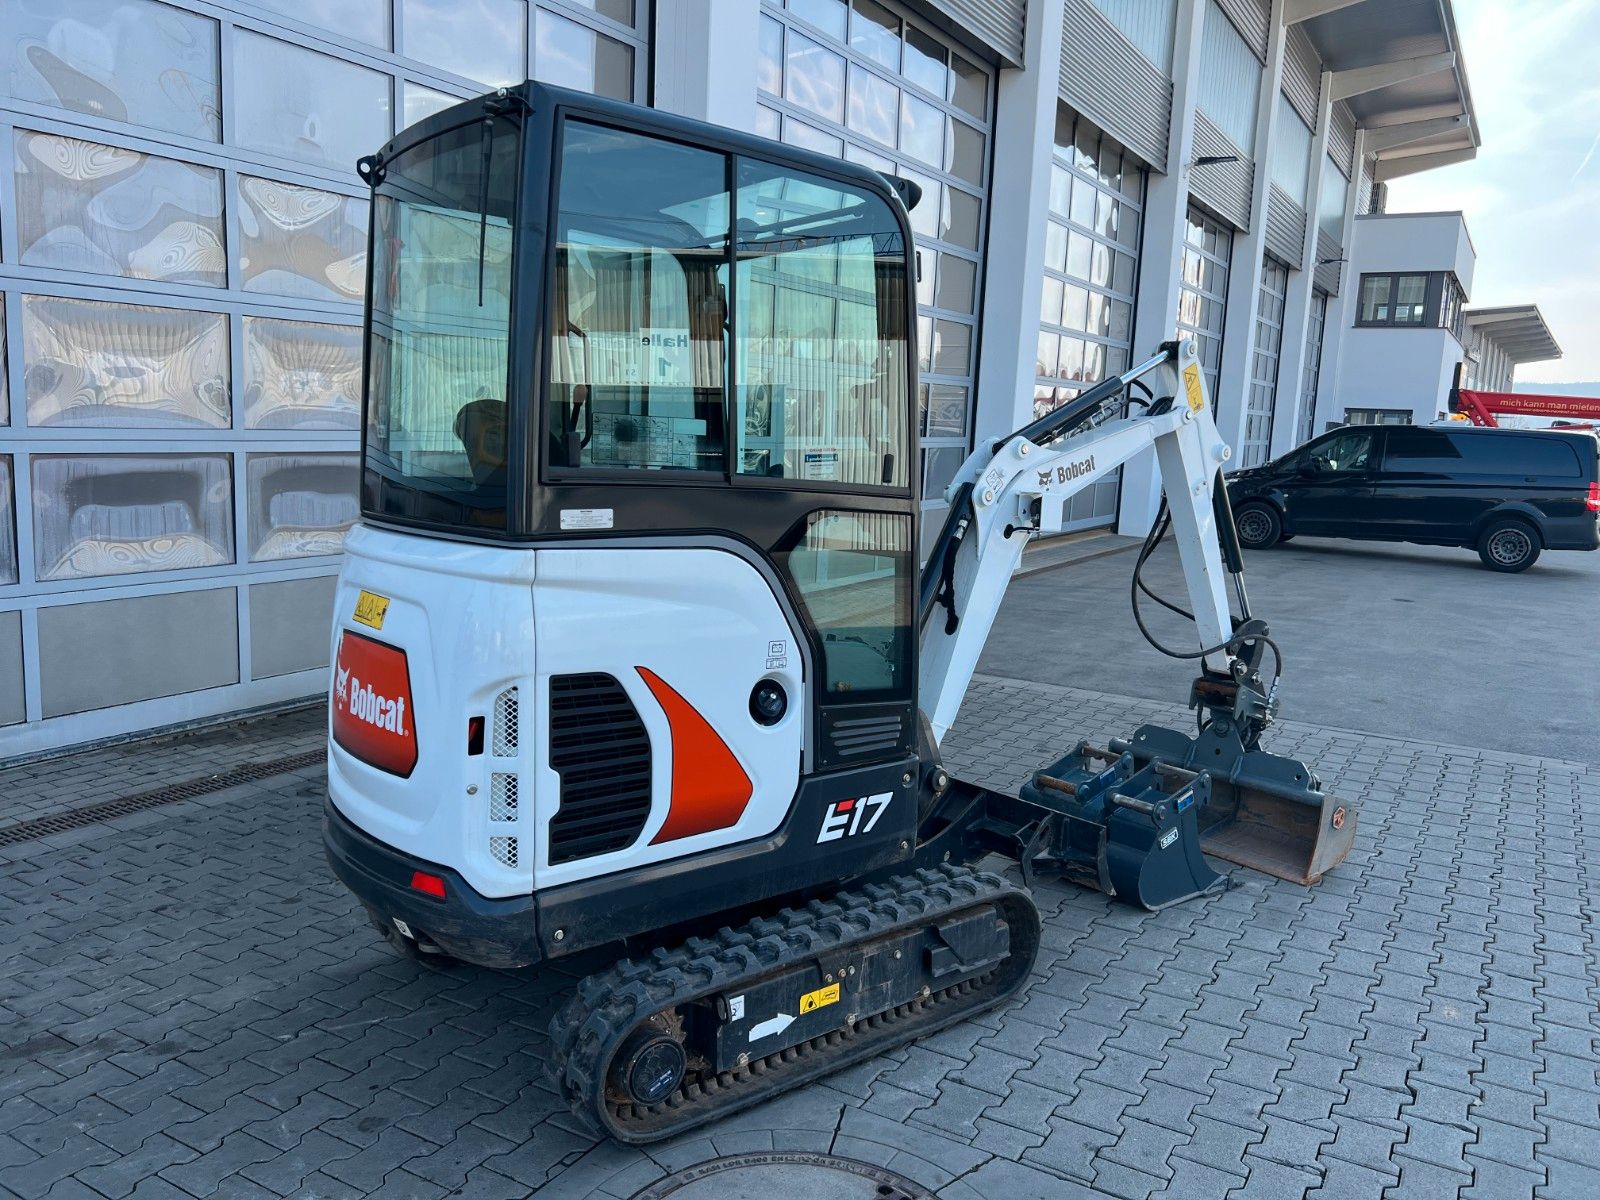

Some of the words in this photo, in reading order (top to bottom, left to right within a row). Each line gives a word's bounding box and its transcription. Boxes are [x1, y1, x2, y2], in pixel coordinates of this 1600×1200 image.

[1500, 399, 1521, 407] mich
[1523, 400, 1545, 409] kann
[1547, 402, 1567, 410] man
[1057, 455, 1095, 484] Bobcat
[350, 677, 405, 736] Bobcat
[816, 791, 894, 844] E17
